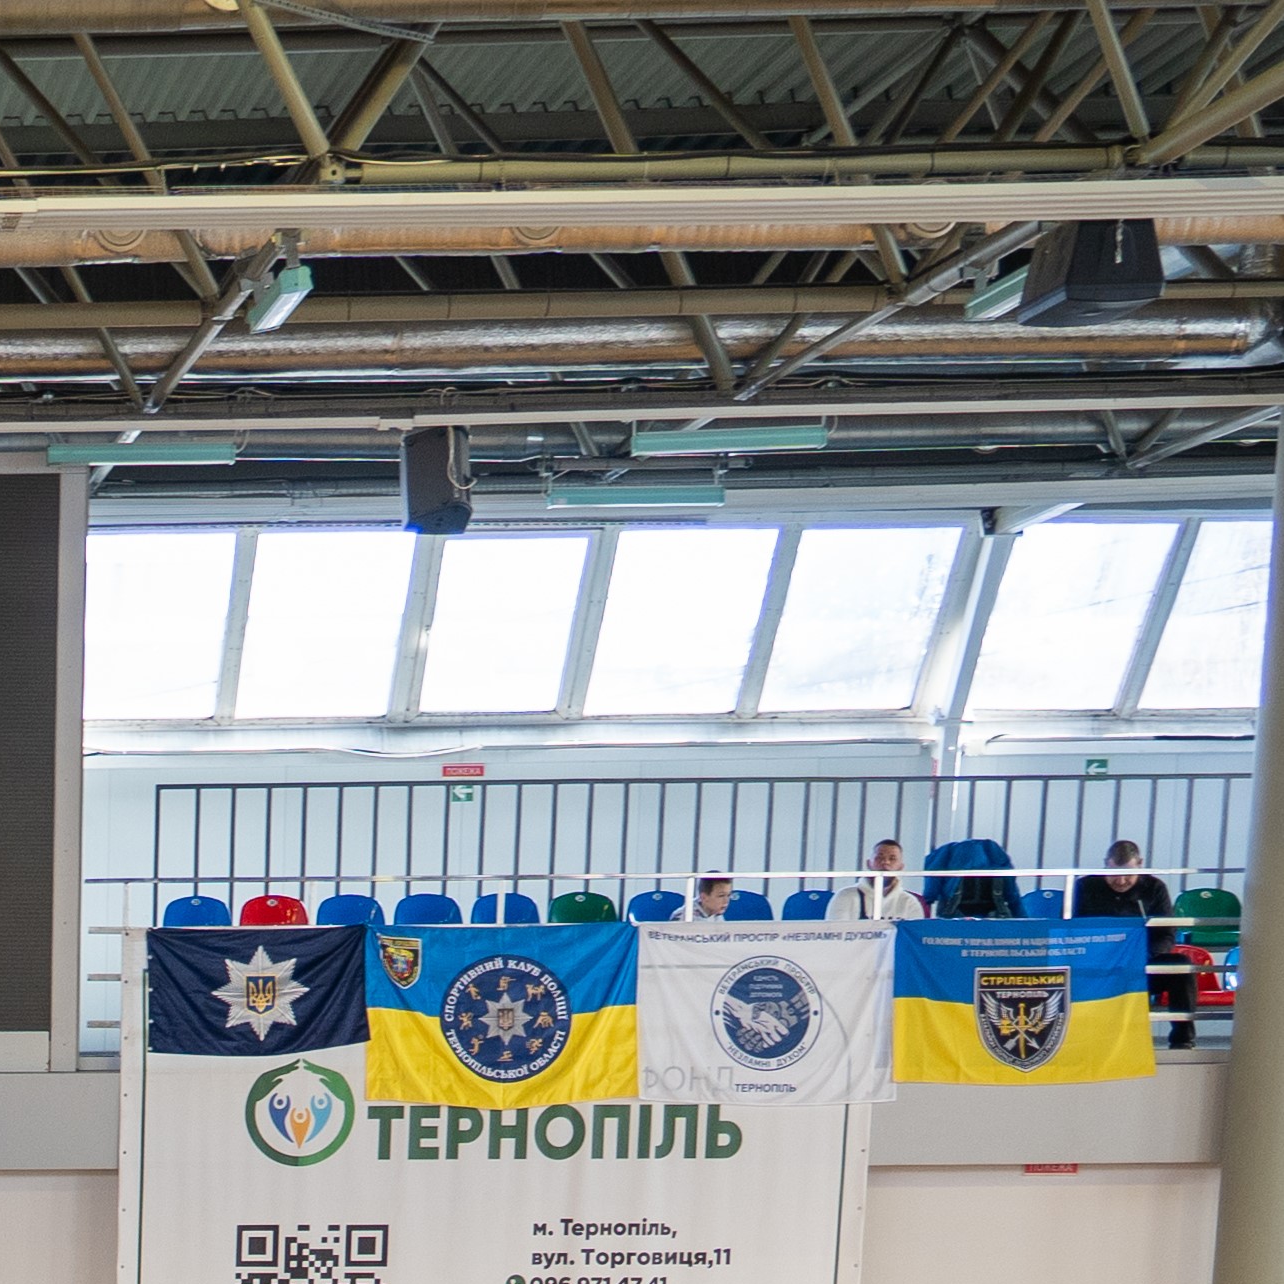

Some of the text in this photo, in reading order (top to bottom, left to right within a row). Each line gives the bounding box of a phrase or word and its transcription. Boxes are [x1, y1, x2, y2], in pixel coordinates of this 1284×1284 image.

[648, 930, 887, 943] ВЕТЕРАНСЬКИЙ ПРОСТІР «НЕЗЛАМНІ ДУХОМ»
[718, 958, 817, 995] ВЕТЕРАНСЬКИЙ ПРОСТІР
[980, 975, 1065, 986] СТРІЛЕЦЬКИЙ
[445, 957, 570, 1022] СПОРТИВНИЙ КЛУБ ПОЛІЦІЇ
[995, 990, 1049, 999] ТЕРНОПІЛЬ
[445, 1029, 566, 1080] ТЕРНОПІЛЬСЬКОЇ ОБЛАСТІ
[734, 1083, 797, 1093] ТЕРНОПІЛЬ
[368, 1103, 744, 1161] ТЕРНОПІЛЬ
[532, 1218, 678, 1240] м. Тернопіль,
[531, 1247, 732, 1270] вул. Торговиця,11
